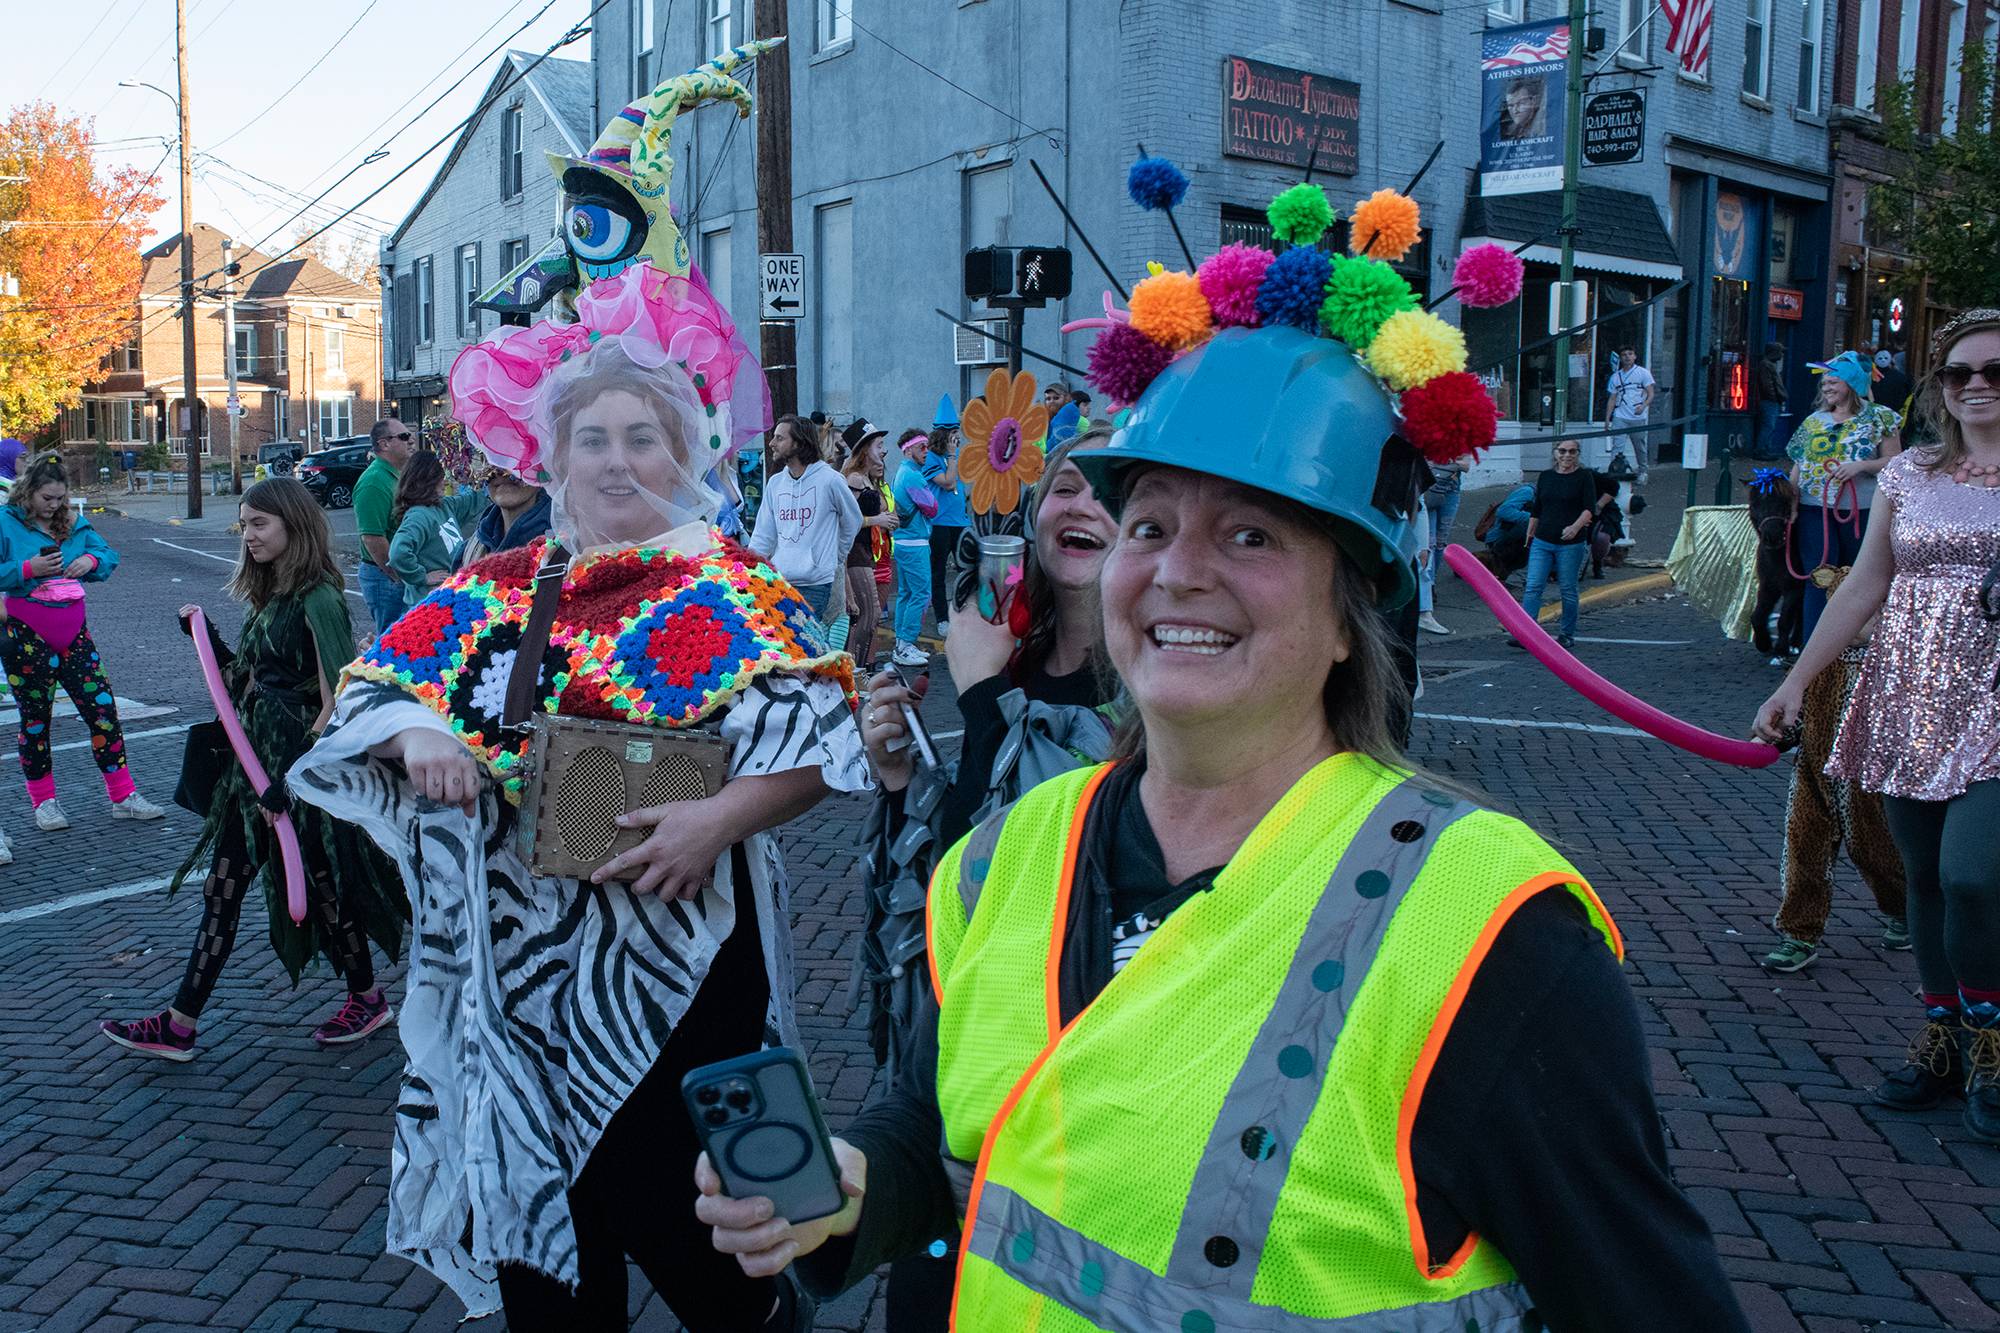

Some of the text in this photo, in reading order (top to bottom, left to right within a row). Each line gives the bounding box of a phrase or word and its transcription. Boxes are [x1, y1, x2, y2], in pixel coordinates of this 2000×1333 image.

[1487, 62, 1564, 81] ATHENS HONORS
[1232, 107, 1293, 146] TATTOO
[1586, 111, 1642, 130] RAPHAEL'S
[1588, 127, 1639, 142] HAIR SALON
[767, 260, 799, 275] ONE
[766, 278, 800, 292] WAY
[1477, 375, 1503, 388] VEDA
